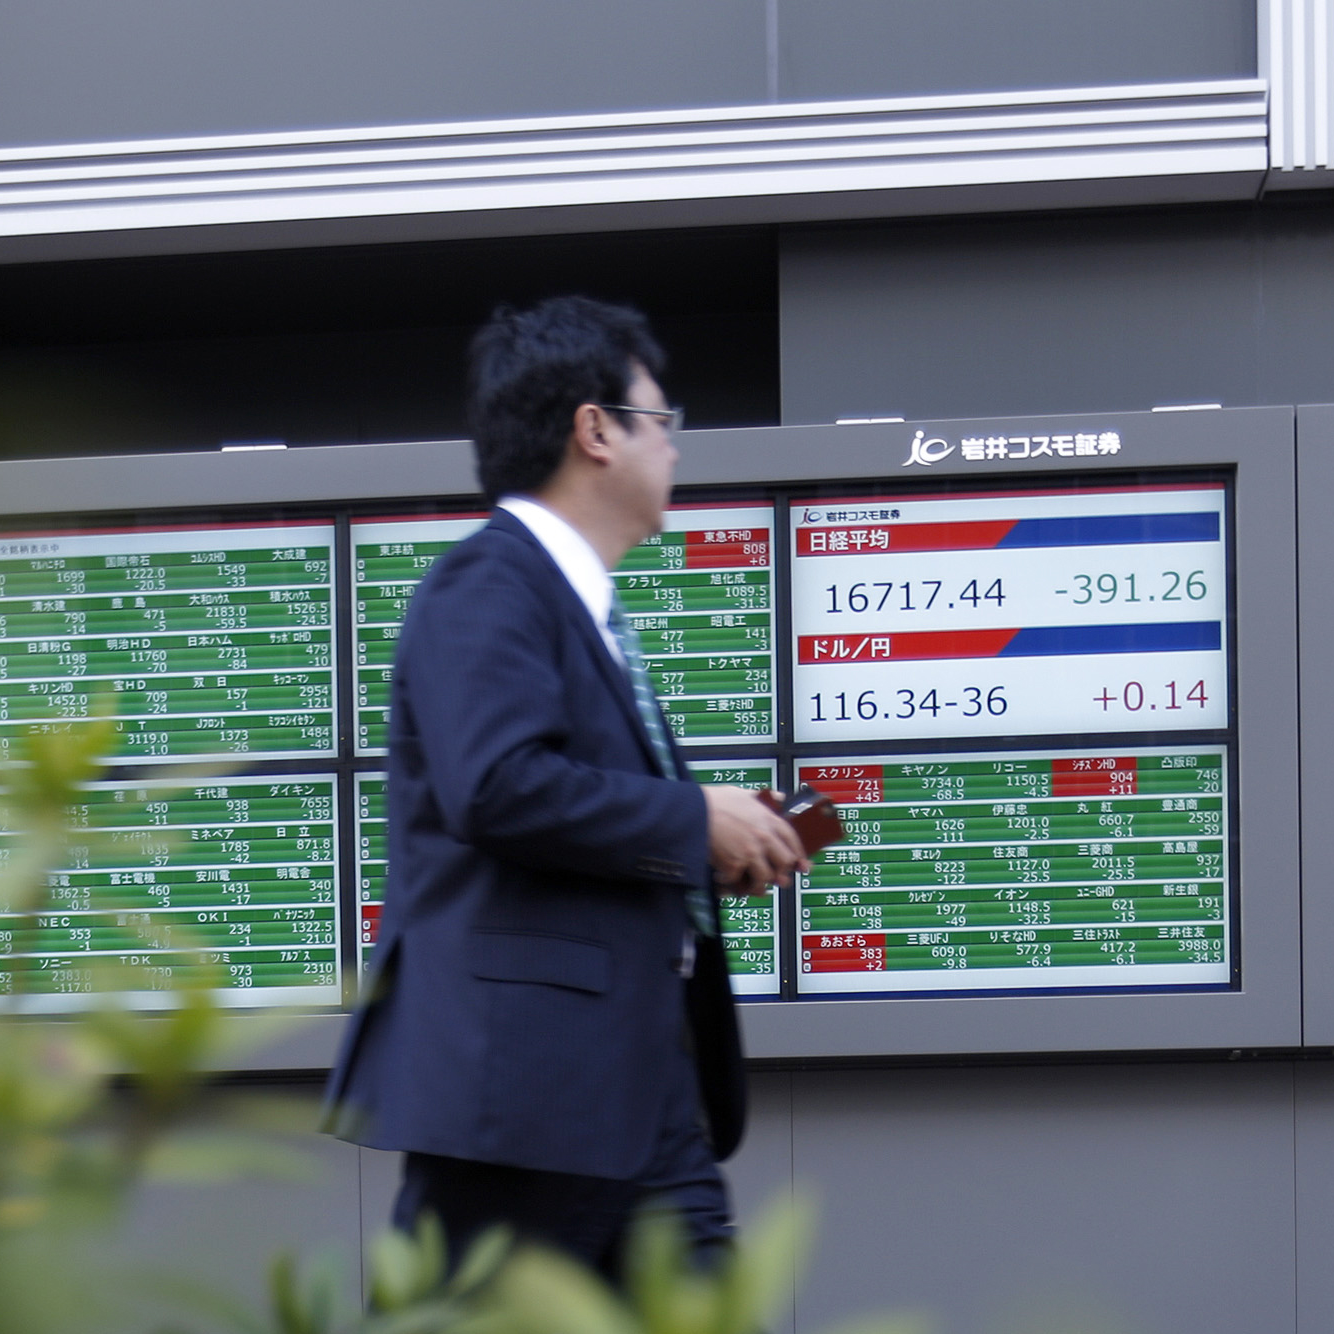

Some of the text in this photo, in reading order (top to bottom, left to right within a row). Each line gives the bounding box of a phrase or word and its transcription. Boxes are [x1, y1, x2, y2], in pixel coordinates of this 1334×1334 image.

[961, 431, 1122, 461] 岩井コスモ証券
[825, 508, 901, 522] 岩井コスモ証券
[809, 530, 891, 553] 日経平均
[743, 542, 765, 554] 808
[272, 550, 305, 560] 大成建
[749, 555, 765, 565] +6
[217, 564, 245, 575] 1549
[305, 561, 326, 572] 692
[627, 576, 661, 588] クラレ
[710, 573, 745, 584] 旭化成
[653, 588, 682, 600] 1351
[725, 585, 765, 596] 1089.5
[825, 570, 1208, 614] 16717.44 -391.26
[206, 605, 245, 617] 2183.0
[287, 602, 327, 614] 1526.5
[296, 614, 326, 625] -24.5
[745, 625, 766, 637] 141
[188, 635, 231, 646] 日本ハム
[131, 649, 166, 661] 11760
[218, 647, 245, 658] 2731
[706, 656, 752, 667] トクヤマ
[745, 667, 767, 679] 234
[810, 680, 1209, 722] 116.34-36 +0.14
[734, 711, 768, 722] 565.5
[220, 729, 247, 740] 1373
[300, 727, 328, 739] 1484
[817, 767, 863, 778] スクリン
[993, 763, 1026, 772] リコー
[1007, 774, 1047, 785] 1150.5
[1110, 771, 1132, 782] 904
[1195, 769, 1217, 780] 746
[857, 779, 878, 790] 721
[921, 776, 963, 788] 3734.0
[1198, 781, 1218, 792] -20
[270, 785, 314, 796] ダイキン
[932, 788, 963, 800] -68.5
[1024, 786, 1048, 796] -4.5
[1109, 783, 1132, 795] +11
[300, 796, 329, 807] 7655
[855, 791, 879, 802] +45
[908, 808, 943, 817] ヤマハ
[992, 804, 1027, 815] 伊藤忠
[1007, 816, 1048, 827] 1201.0
[1099, 814, 1133, 825] 660.7
[1188, 811, 1218, 822] 2550
[935, 818, 964, 830] 1626
[1199, 823, 1218, 835] -59
[937, 831, 963, 842] -111
[1024, 828, 1049, 839] -2.5
[1109, 826, 1133, 837] -6.1
[848, 834, 880, 844] -29.0
[993, 846, 1027, 857] 住友商
[1078, 844, 1112, 855] 三菱商
[825, 851, 859, 862] 三井物
[1092, 856, 1134, 867] 2011.5
[1196, 854, 1219, 865] 937
[839, 863, 880, 874] 1482.5
[934, 861, 964, 872] 8223
[1008, 858, 1049, 870] 1127.0
[196, 870, 229, 881] 安川電
[1017, 871, 1049, 882] -25.5
[1102, 868, 1134, 879] -25.5
[1199, 866, 1219, 876] -17
[857, 876, 880, 886] -8.5
[937, 873, 964, 884] -122
[222, 882, 249, 893] 1431
[994, 889, 1028, 899] イオン
[1009, 901, 1049, 912] 1148.5
[1112, 898, 1133, 910] 621
[1198, 896, 1218, 907] 191
[852, 905, 881, 916] 1048
[936, 903, 965, 914] 1977
[1207, 908, 1219, 920] -3
[39, 917, 69, 926] NEC
[946, 915, 965, 926] -49
[1018, 913, 1050, 924] -32.5
[1115, 911, 1134, 922] -15
[861, 918, 881, 928] -38
[69, 928, 90, 939] 353
[990, 930, 1035, 942] りそなHD
[1157, 926, 1204, 937] 三井住友
[821, 935, 865, 946] あおぞら
[1178, 939, 1220, 950] 3988.0
[931, 945, 966, 956] 609.0
[1016, 943, 1050, 954] 577.9
[1100, 941, 1135, 952] 417.2
[860, 947, 881, 958] 383
[1188, 951, 1220, 962] -34.5
[942, 958, 966, 968] -9.8
[1026, 956, 1050, 966] -6.4
[1111, 954, 1134, 964] -6.1
[866, 960, 882, 970] +2
